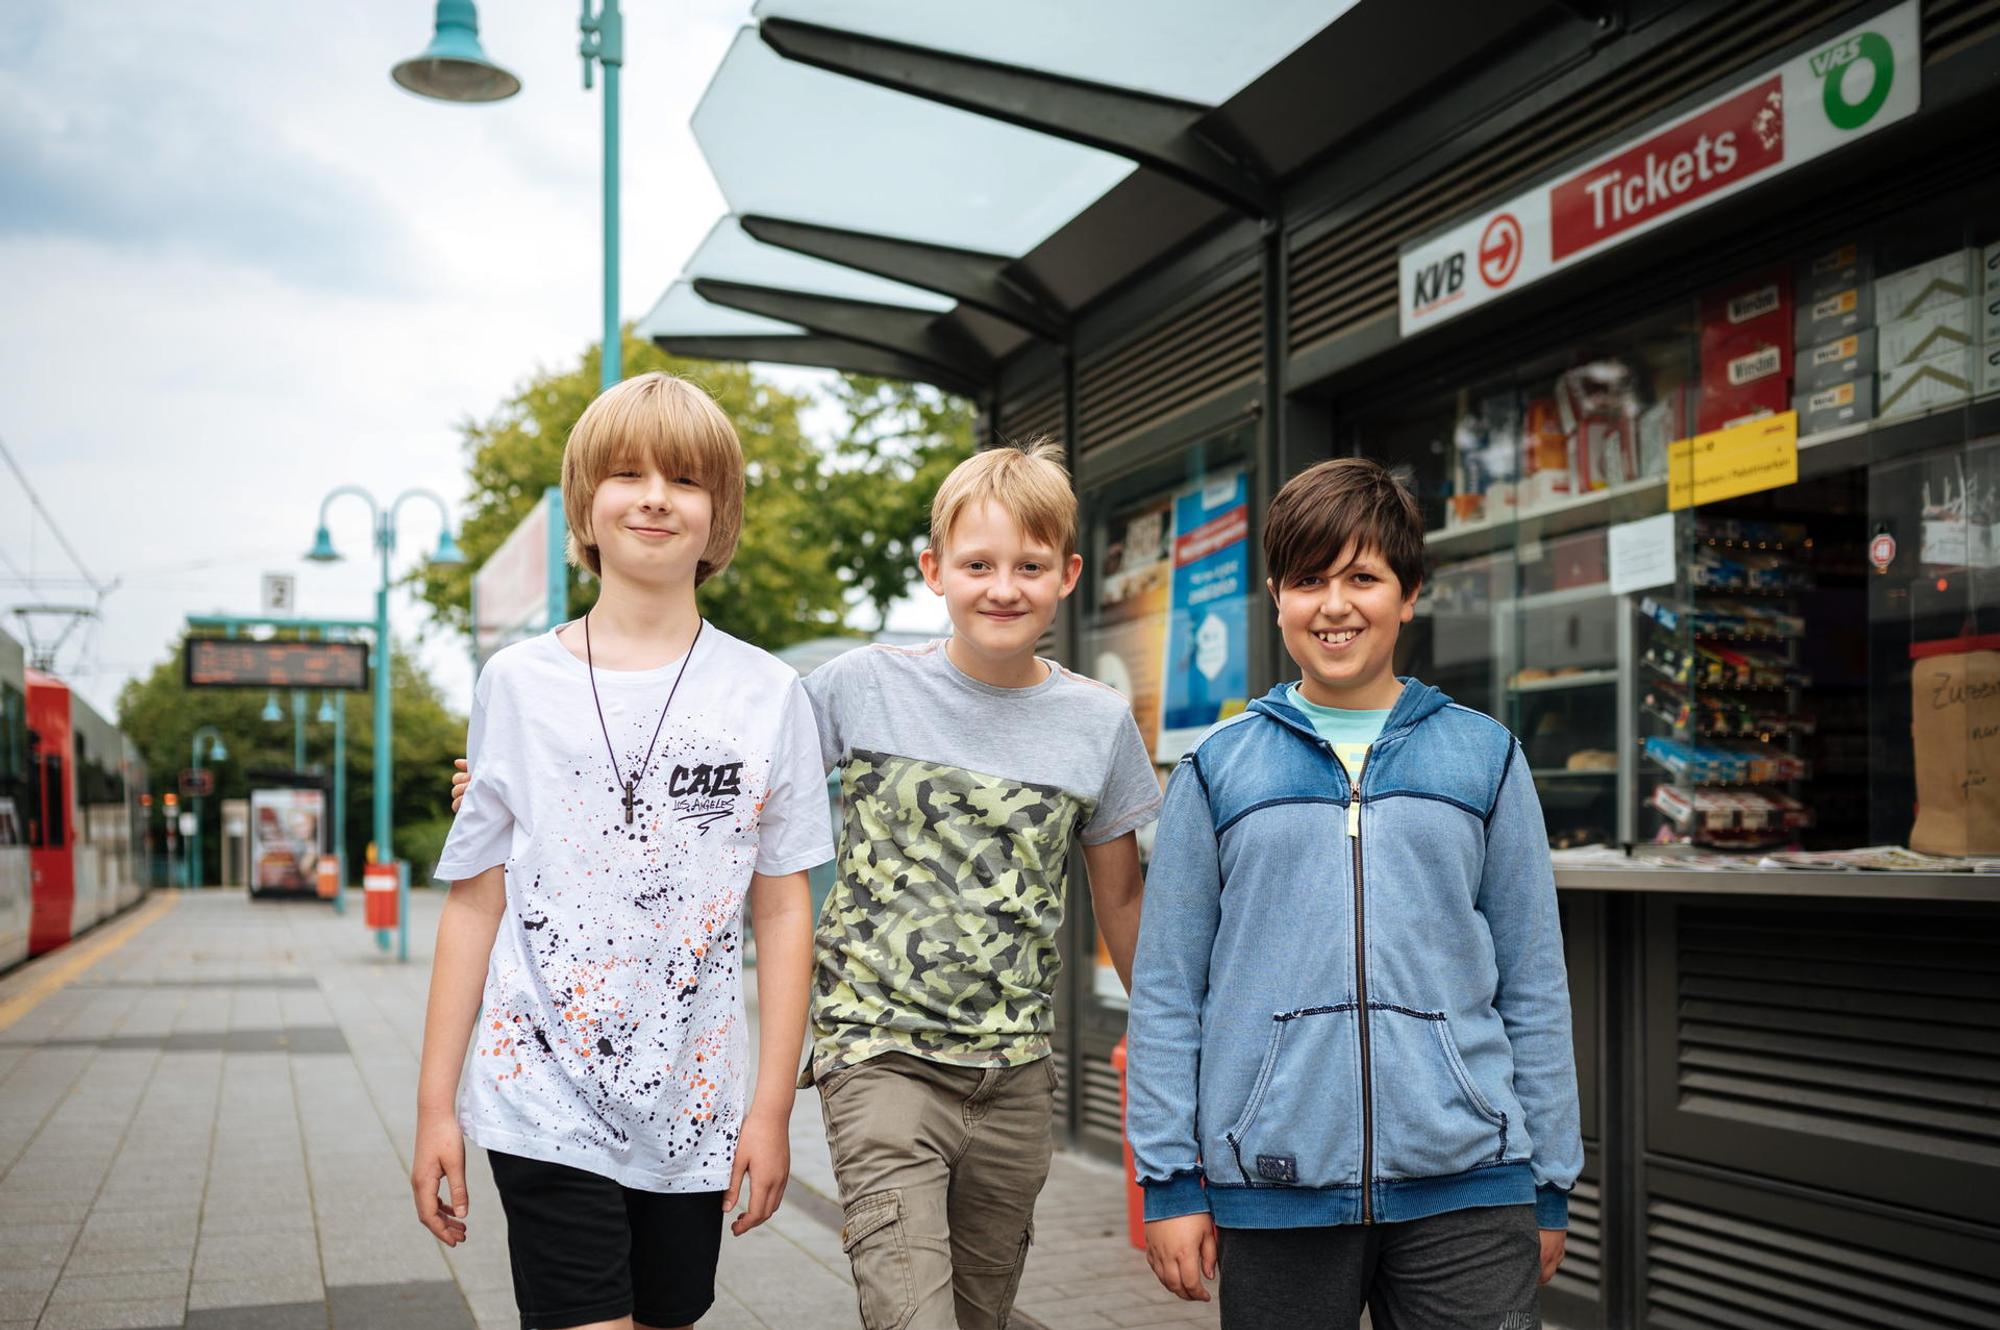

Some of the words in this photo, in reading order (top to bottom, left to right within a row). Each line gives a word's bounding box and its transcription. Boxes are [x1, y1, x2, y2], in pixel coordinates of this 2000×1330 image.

[1810, 38, 1861, 75] VRS
[1585, 130, 1739, 229] Tickets
[1414, 252, 1465, 308] KVB
[272, 580, 288, 608] 2
[668, 761, 744, 798] CALI
[692, 798, 735, 812] ANGELES
[1505, 1311, 1531, 1328] NIKE
